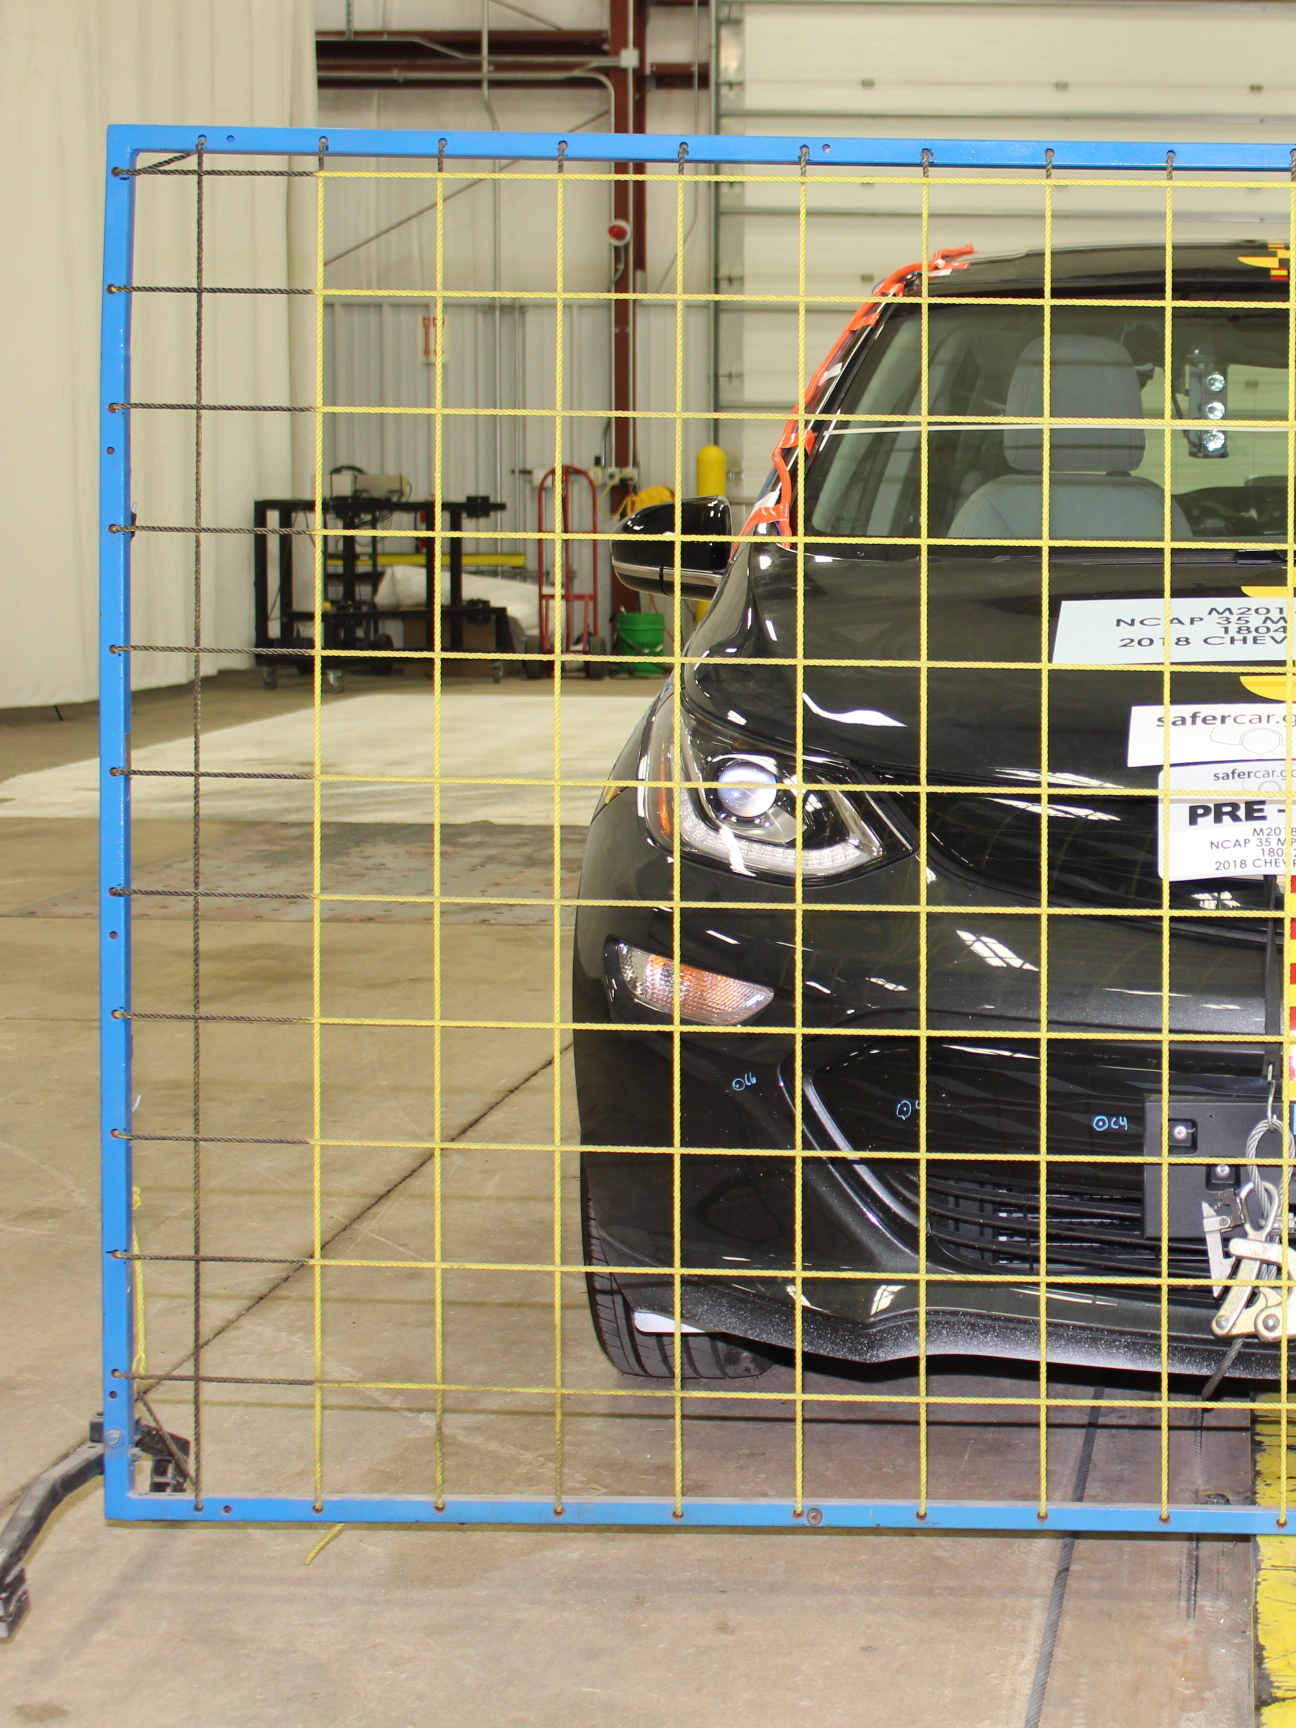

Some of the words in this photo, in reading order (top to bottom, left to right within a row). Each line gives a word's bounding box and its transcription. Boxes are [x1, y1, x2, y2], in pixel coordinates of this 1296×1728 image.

[1115, 617, 1205, 628] NCAP
[1216, 616, 1251, 625] 35
[1118, 636, 1191, 648] 2018
[1188, 800, 1268, 827] PRE
[1209, 838, 1250, 850] NCAP
[1256, 838, 1272, 847] 35
[1214, 860, 1247, 871] 2018
[1110, 1116, 1128, 1131] C4
